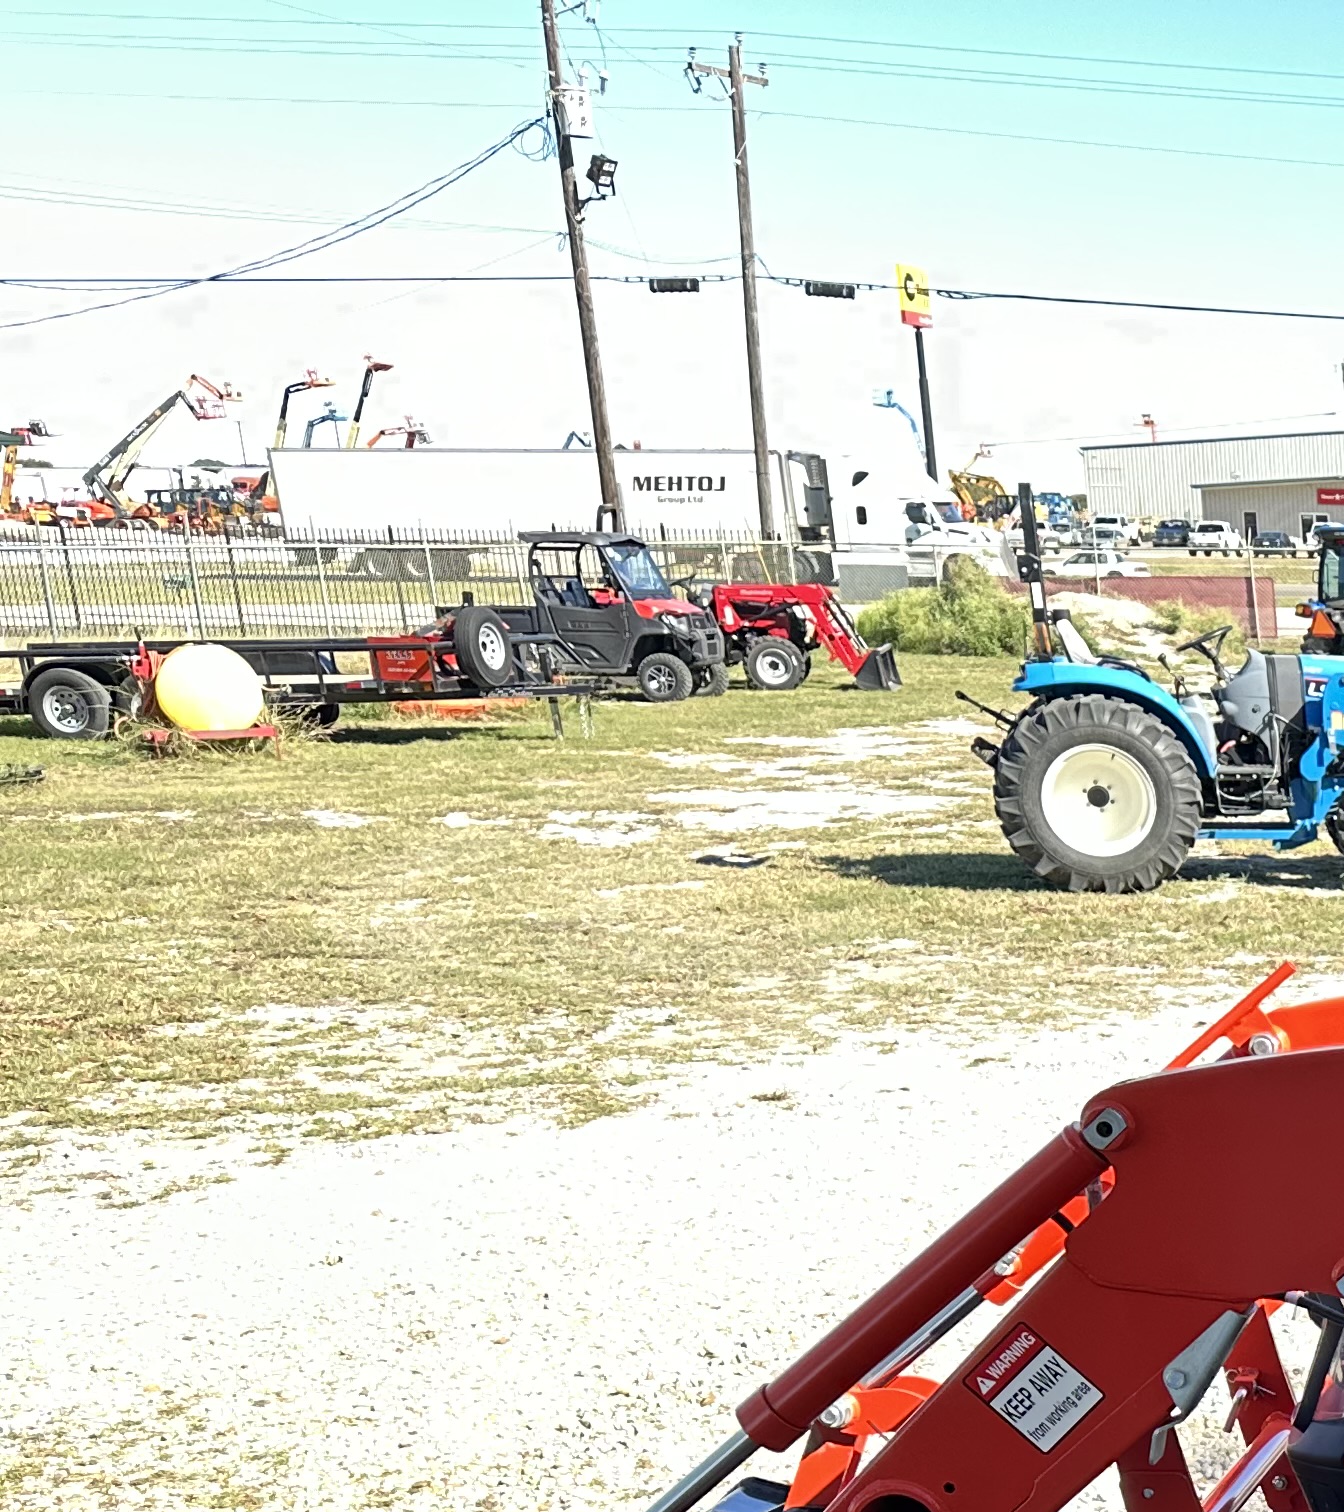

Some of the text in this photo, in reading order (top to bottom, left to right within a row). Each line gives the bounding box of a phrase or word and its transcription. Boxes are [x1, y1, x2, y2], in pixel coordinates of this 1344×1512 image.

[633, 476, 725, 491] MEHTOJ
[657, 495, 685, 504] Group
[985, 1331, 1036, 1380] WARNING
[1000, 1355, 1068, 1424] KEEP AWAY
[1026, 1381, 1092, 1442] from working area
